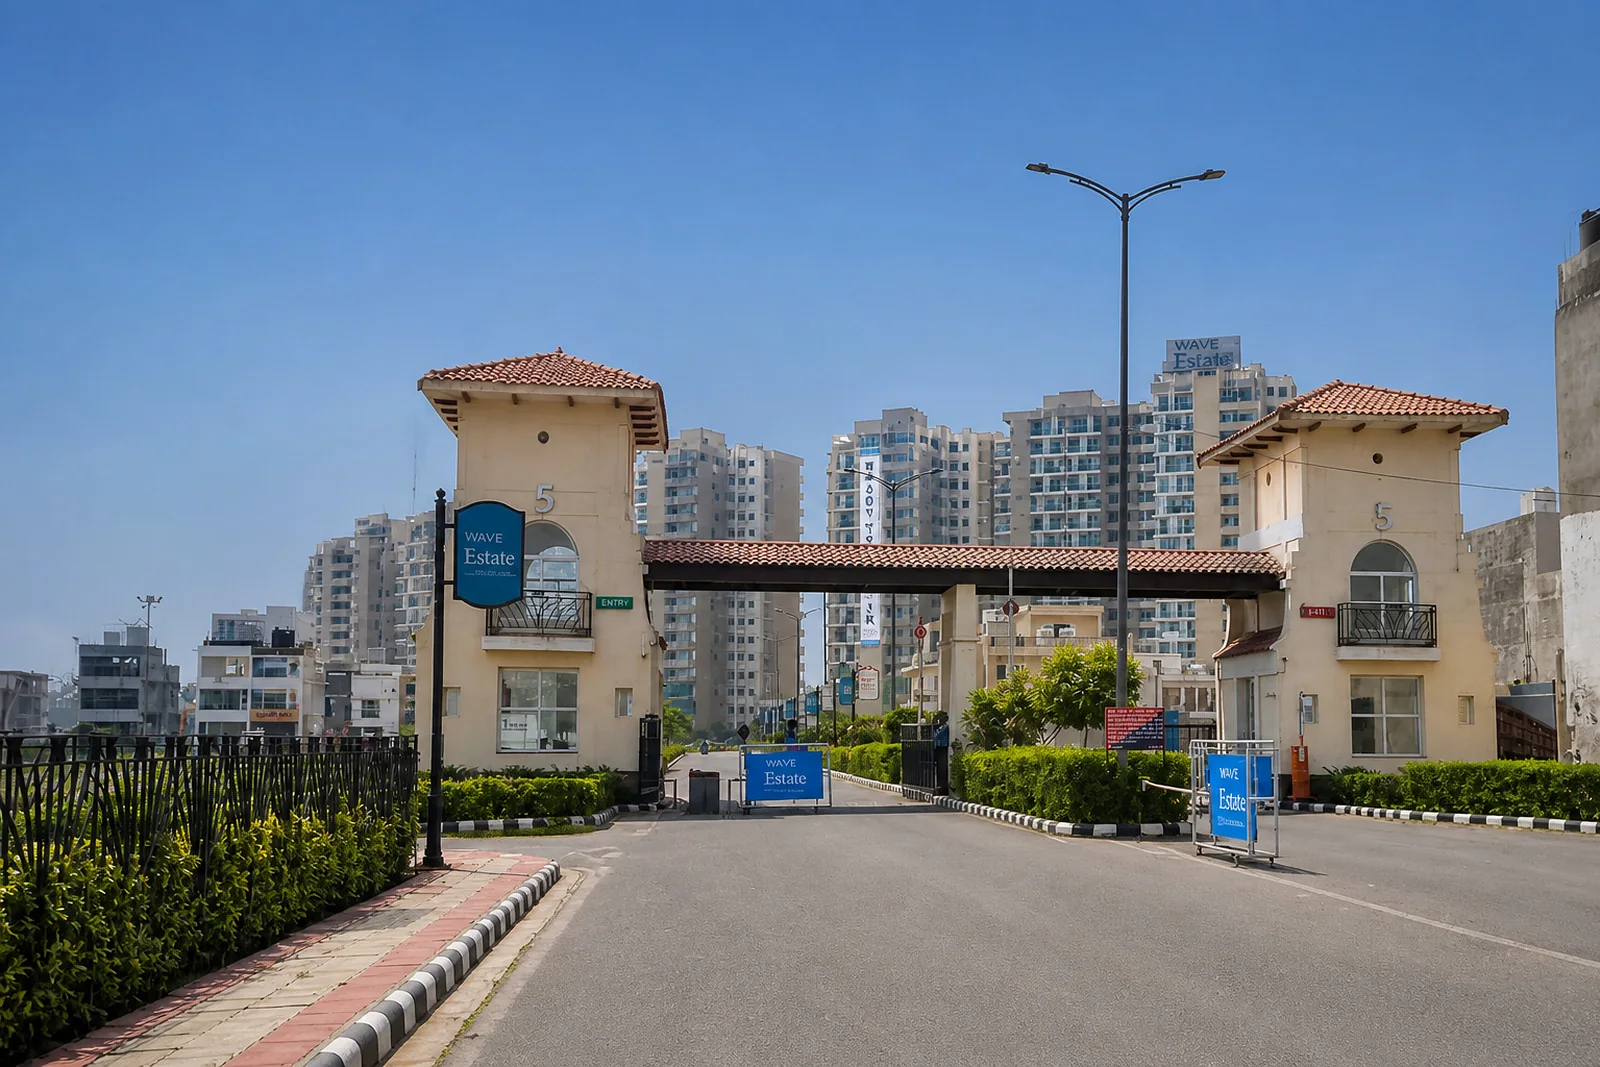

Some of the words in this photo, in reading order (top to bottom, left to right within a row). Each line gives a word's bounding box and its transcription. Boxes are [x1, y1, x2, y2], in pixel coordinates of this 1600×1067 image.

[1175, 338, 1219, 351] WAVE
[535, 484, 554, 513] 5
[1375, 503, 1393, 531] 5
[465, 531, 503, 544] WAVE
[463, 547, 515, 566] Estate
[765, 759, 796, 767] WAVE
[764, 771, 807, 786] Estate
[1219, 767, 1239, 780] WAVE
